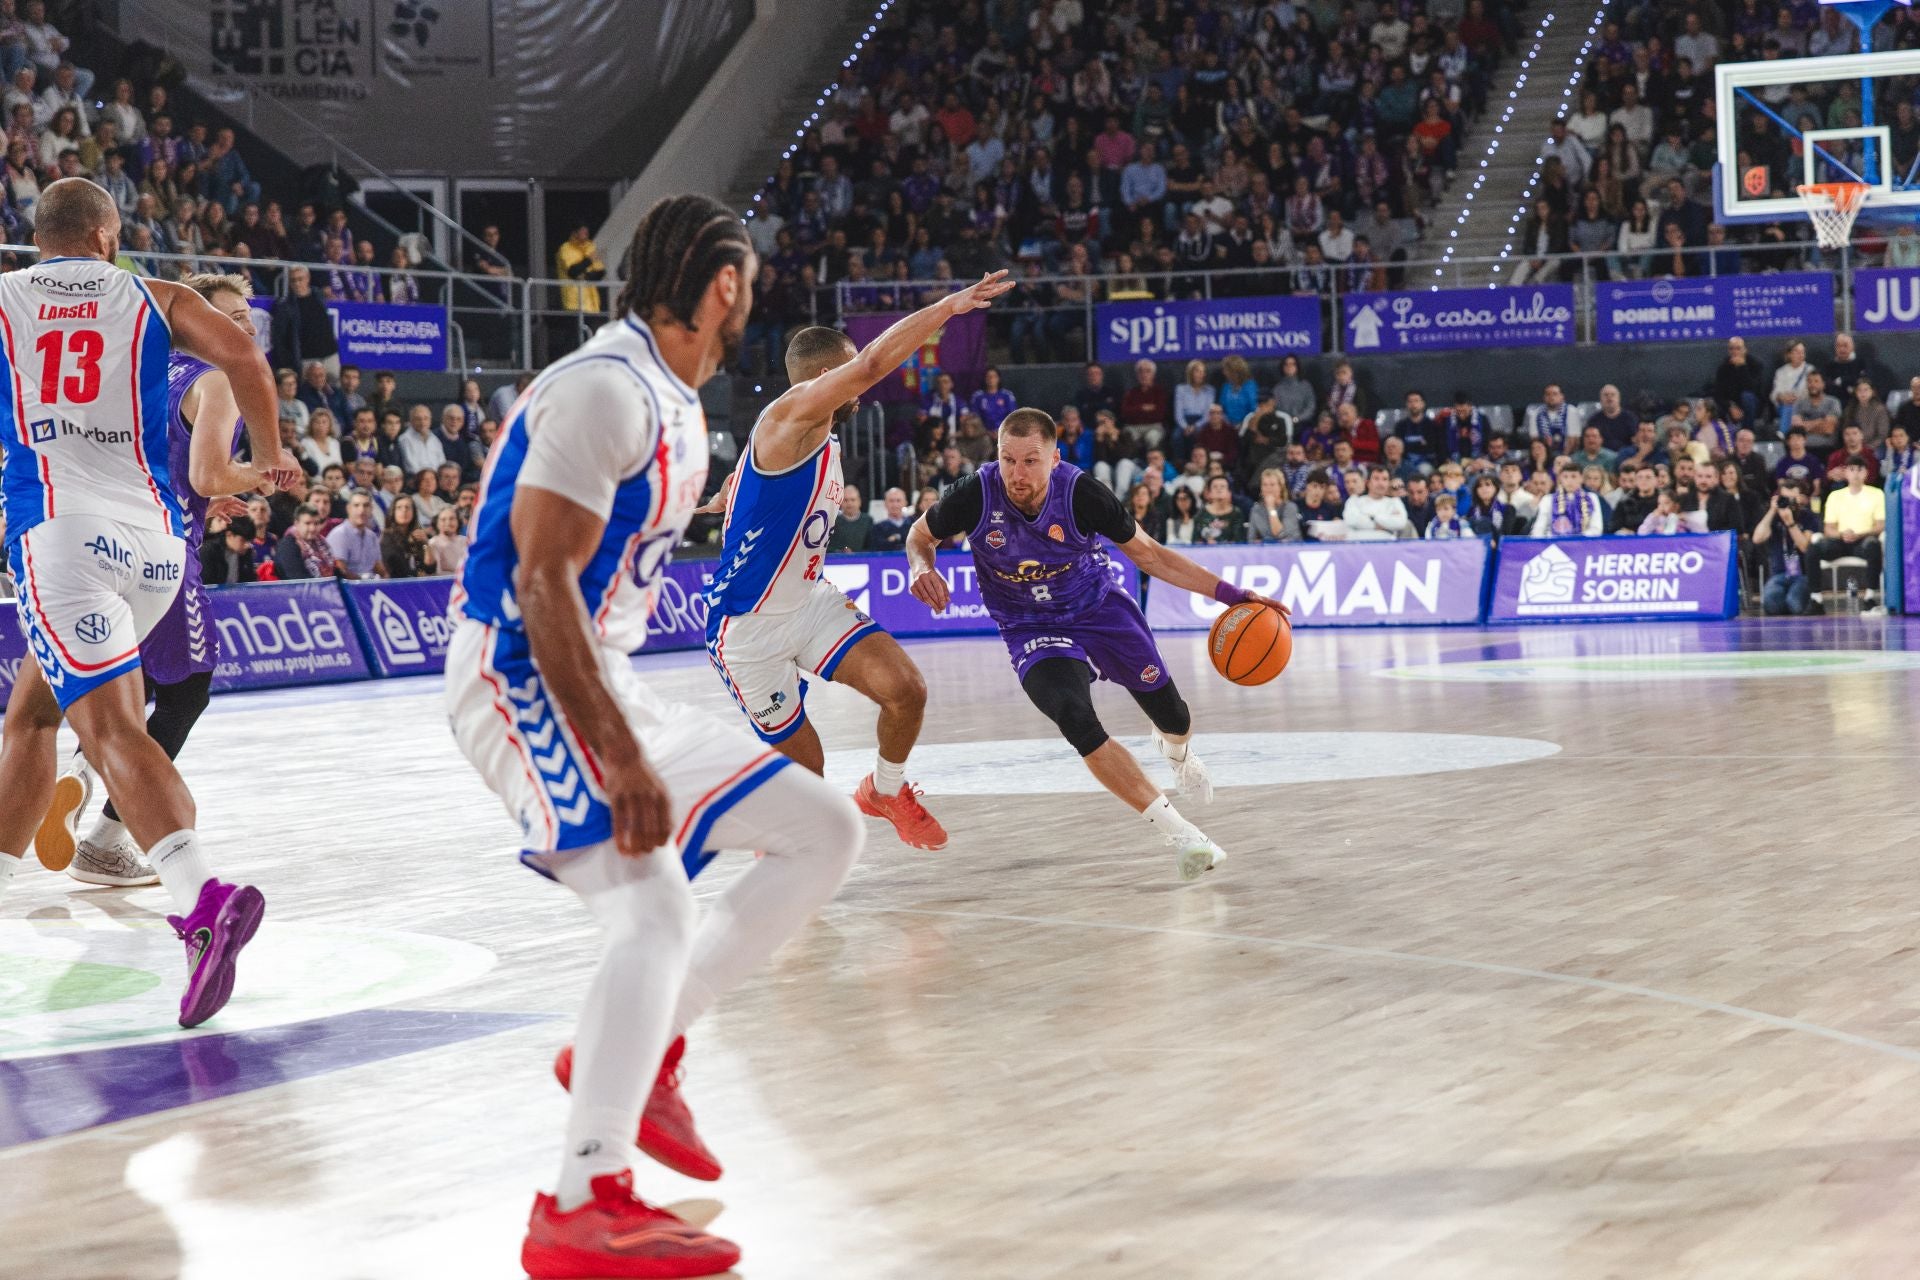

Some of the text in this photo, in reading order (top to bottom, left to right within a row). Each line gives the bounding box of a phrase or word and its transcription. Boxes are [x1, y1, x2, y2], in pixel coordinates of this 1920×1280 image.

[296, 48, 354, 76] CIA
[38, 301, 98, 320] LARSEN
[1195, 310, 1281, 330] SABORES
[1392, 291, 1572, 329] La casa dulce
[1196, 330, 1311, 350] PALENTINOS
[35, 329, 104, 405] 13
[1584, 551, 1704, 577] HERRERO
[1031, 585, 1053, 602] 8
[1582, 577, 1680, 602] SOBRIN
[753, 701, 782, 719] suma
